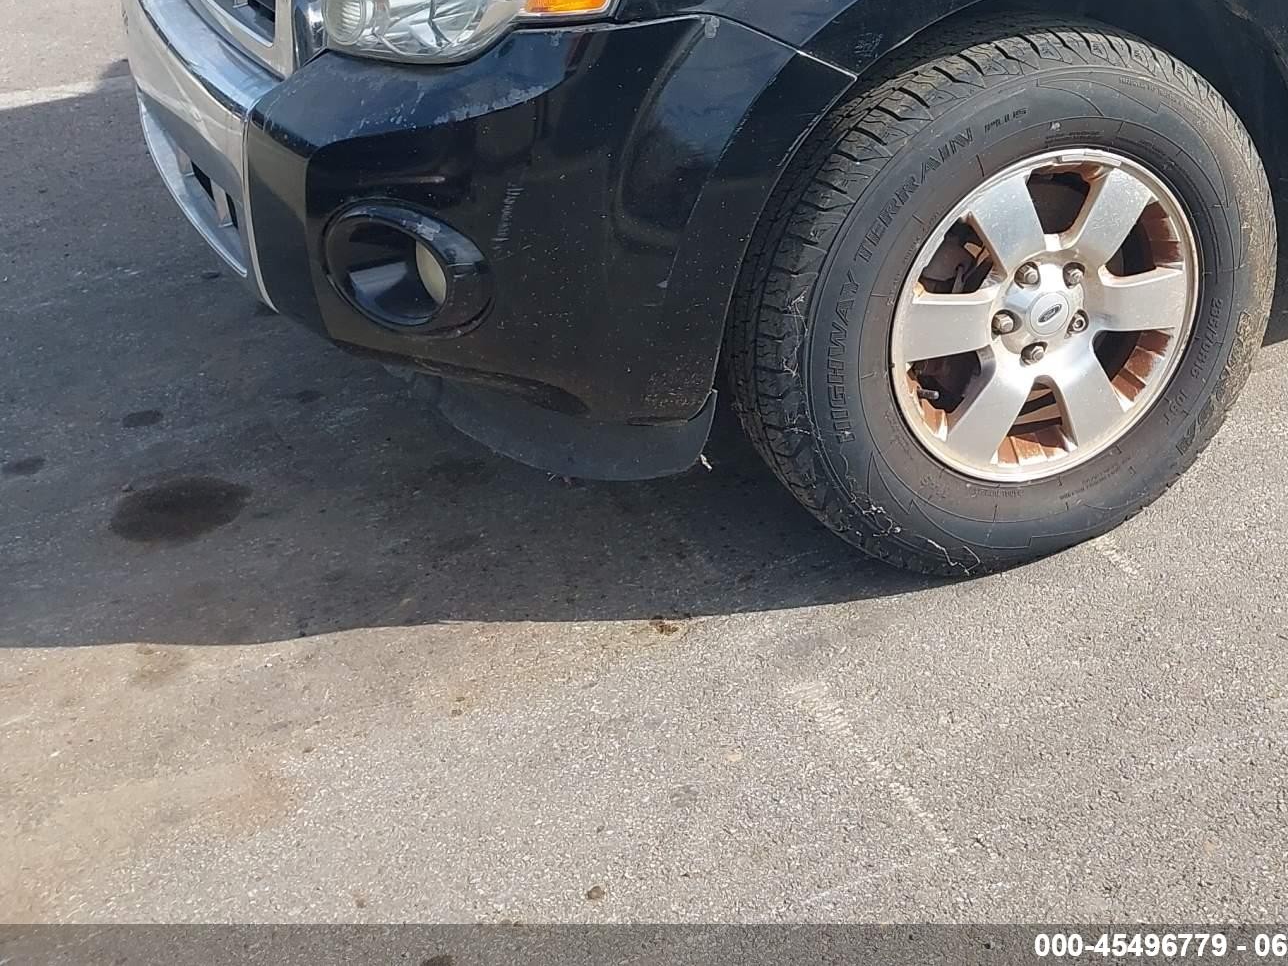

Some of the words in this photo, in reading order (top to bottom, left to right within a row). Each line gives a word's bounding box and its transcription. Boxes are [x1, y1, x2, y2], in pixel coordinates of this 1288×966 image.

[827, 269, 860, 444] HIGHWAY
[854, 126, 974, 263] TERRAIN
[984, 107, 1028, 133] PLUS
